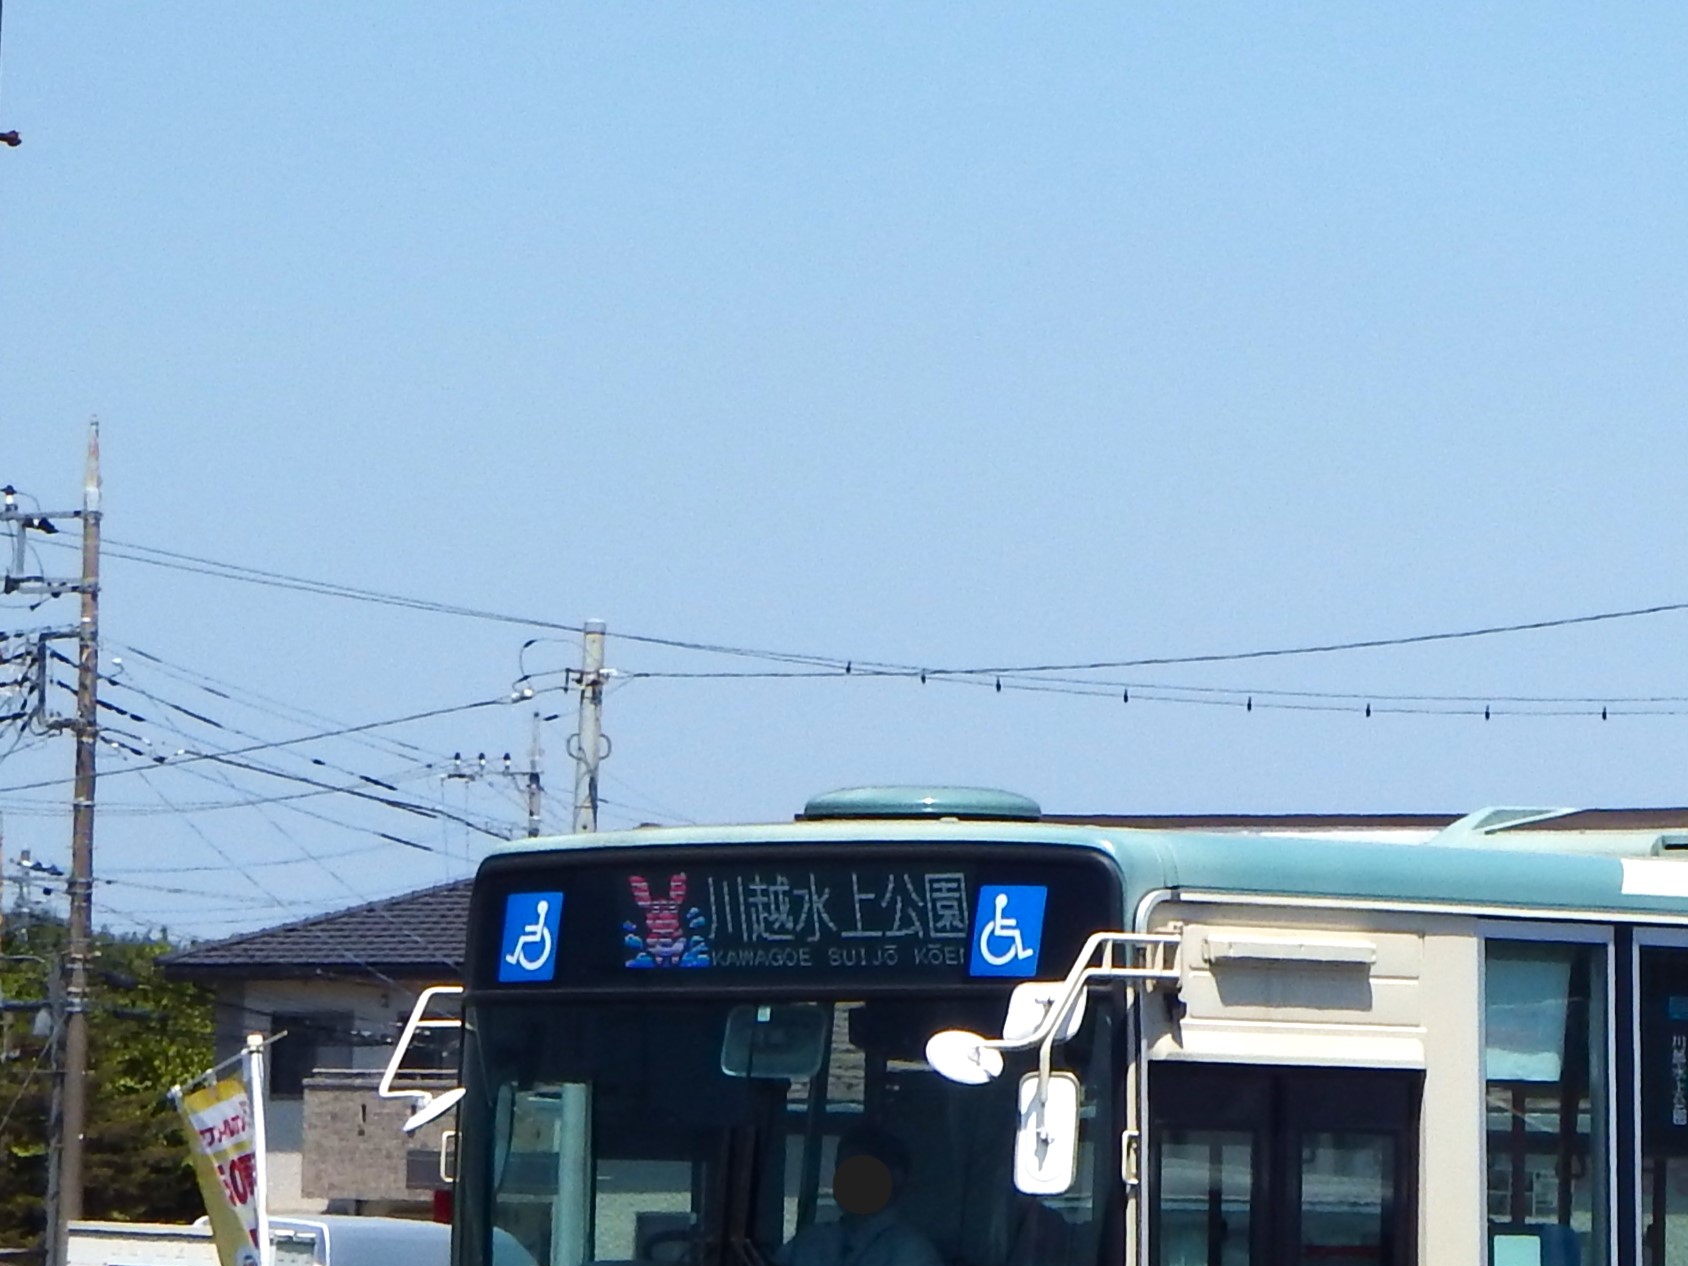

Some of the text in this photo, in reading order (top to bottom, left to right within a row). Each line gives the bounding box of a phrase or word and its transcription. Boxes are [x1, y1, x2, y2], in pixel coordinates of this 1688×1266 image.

[707, 872, 968, 943] 川越水上公園
[711, 948, 812, 967] KAWAGOE
